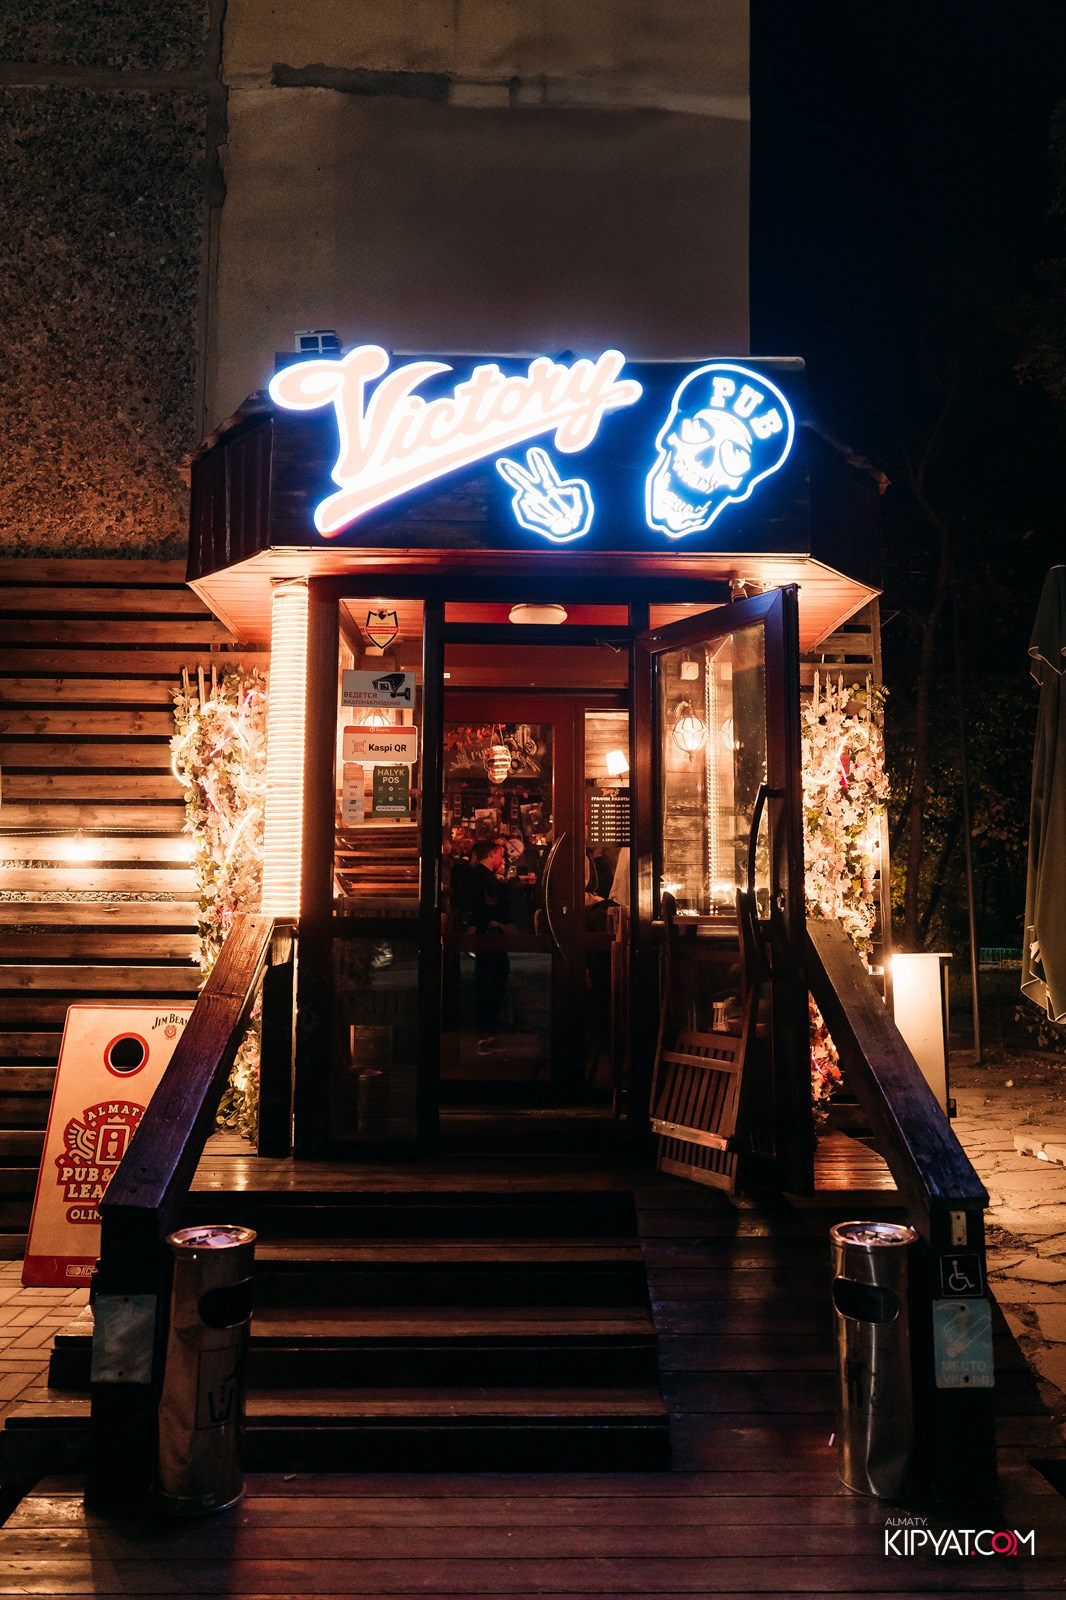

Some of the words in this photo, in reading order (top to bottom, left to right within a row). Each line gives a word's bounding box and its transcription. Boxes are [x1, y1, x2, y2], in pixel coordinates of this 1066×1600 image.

[710, 376, 783, 439] PUB
[269, 345, 643, 537] Victory
[343, 691, 378, 699] ВЕДЕТСЯ
[368, 743, 393, 753] Kaspi
[394, 744, 407, 752] QR
[382, 776, 400, 784] POS
[151, 1016, 168, 1030] JIM
[61, 1167, 99, 1181] PUB
